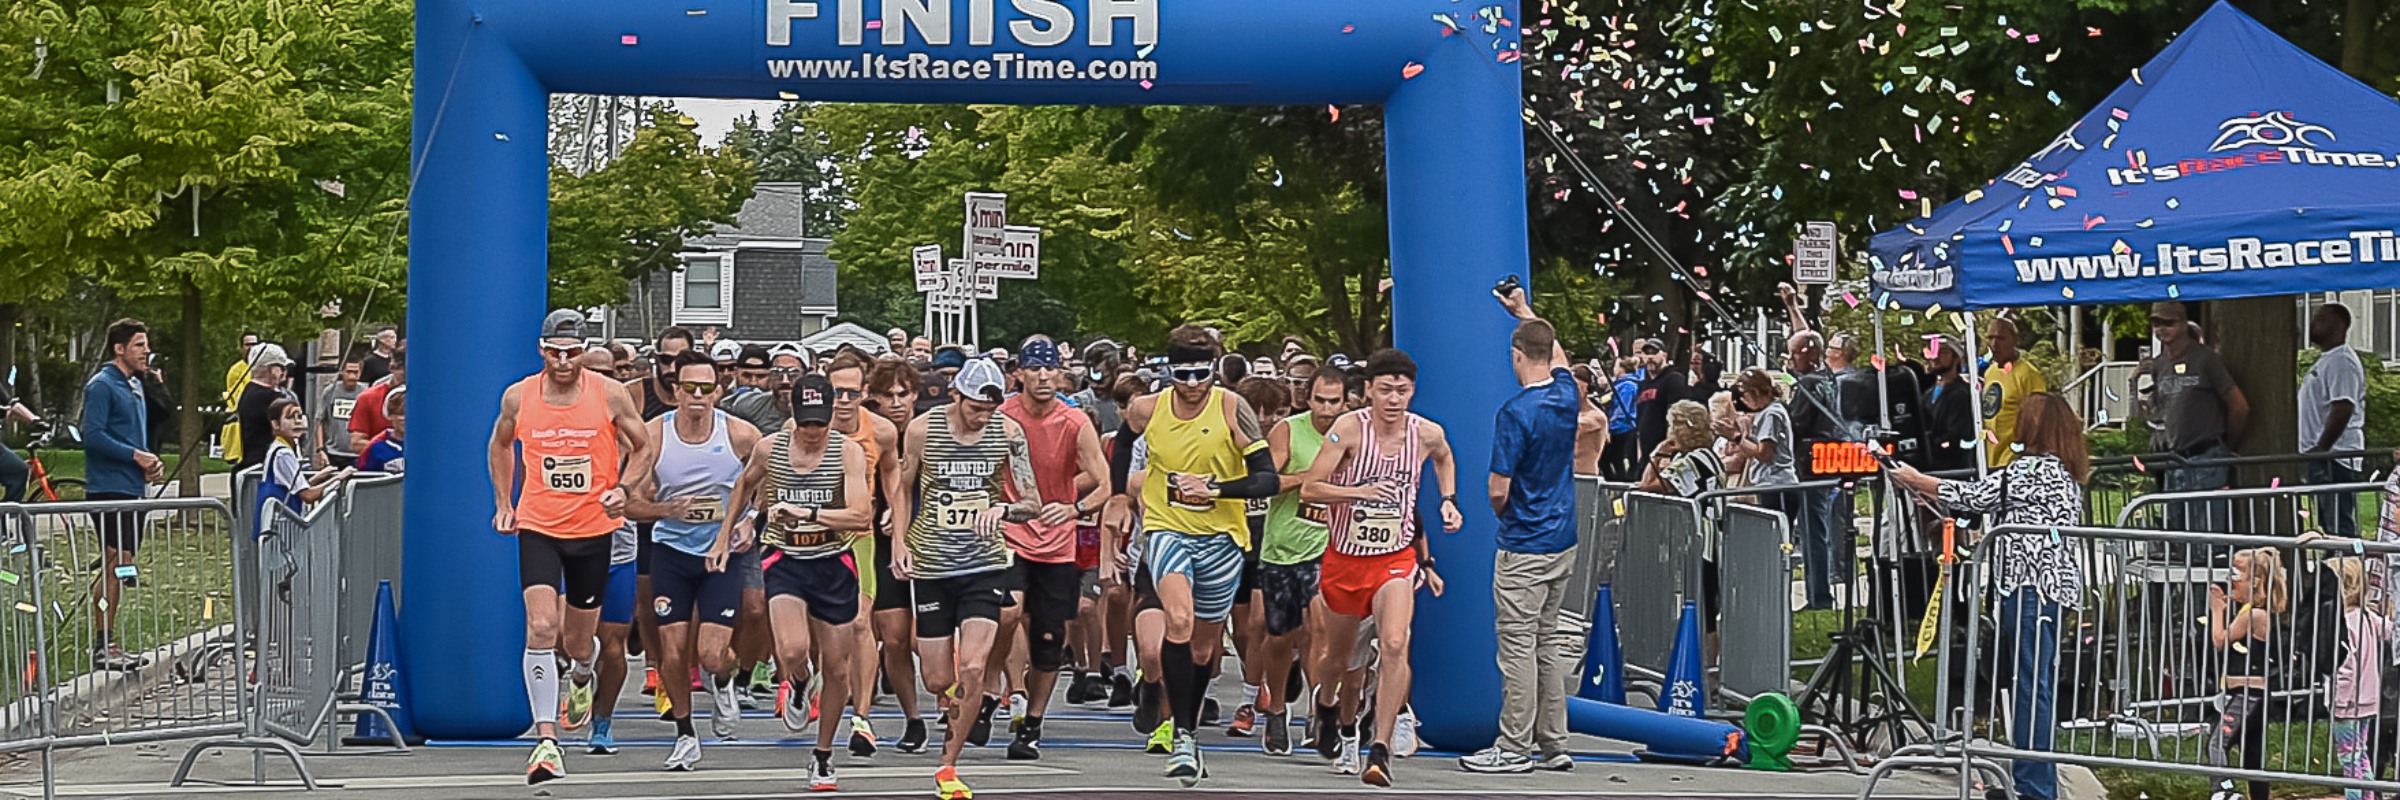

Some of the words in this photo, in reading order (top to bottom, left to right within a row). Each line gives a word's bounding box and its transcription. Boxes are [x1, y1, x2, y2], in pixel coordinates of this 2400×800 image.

[765, 0, 1159, 47] FINISH
[767, 52, 1158, 80] www.ItsRaceTime.com
[2107, 145, 2400, 187] It'sRaceTime.
[2014, 230, 2400, 283] www.ItsRaceTi
[974, 261, 1000, 274] per
[1001, 259, 1032, 272] mile
[937, 461, 996, 476] PLAINFIELD
[550, 472, 585, 488] 650
[777, 488, 834, 503] PLAINFIELD
[946, 507, 978, 526] 371
[793, 533, 828, 546] 1071
[1356, 525, 1391, 543] 380
